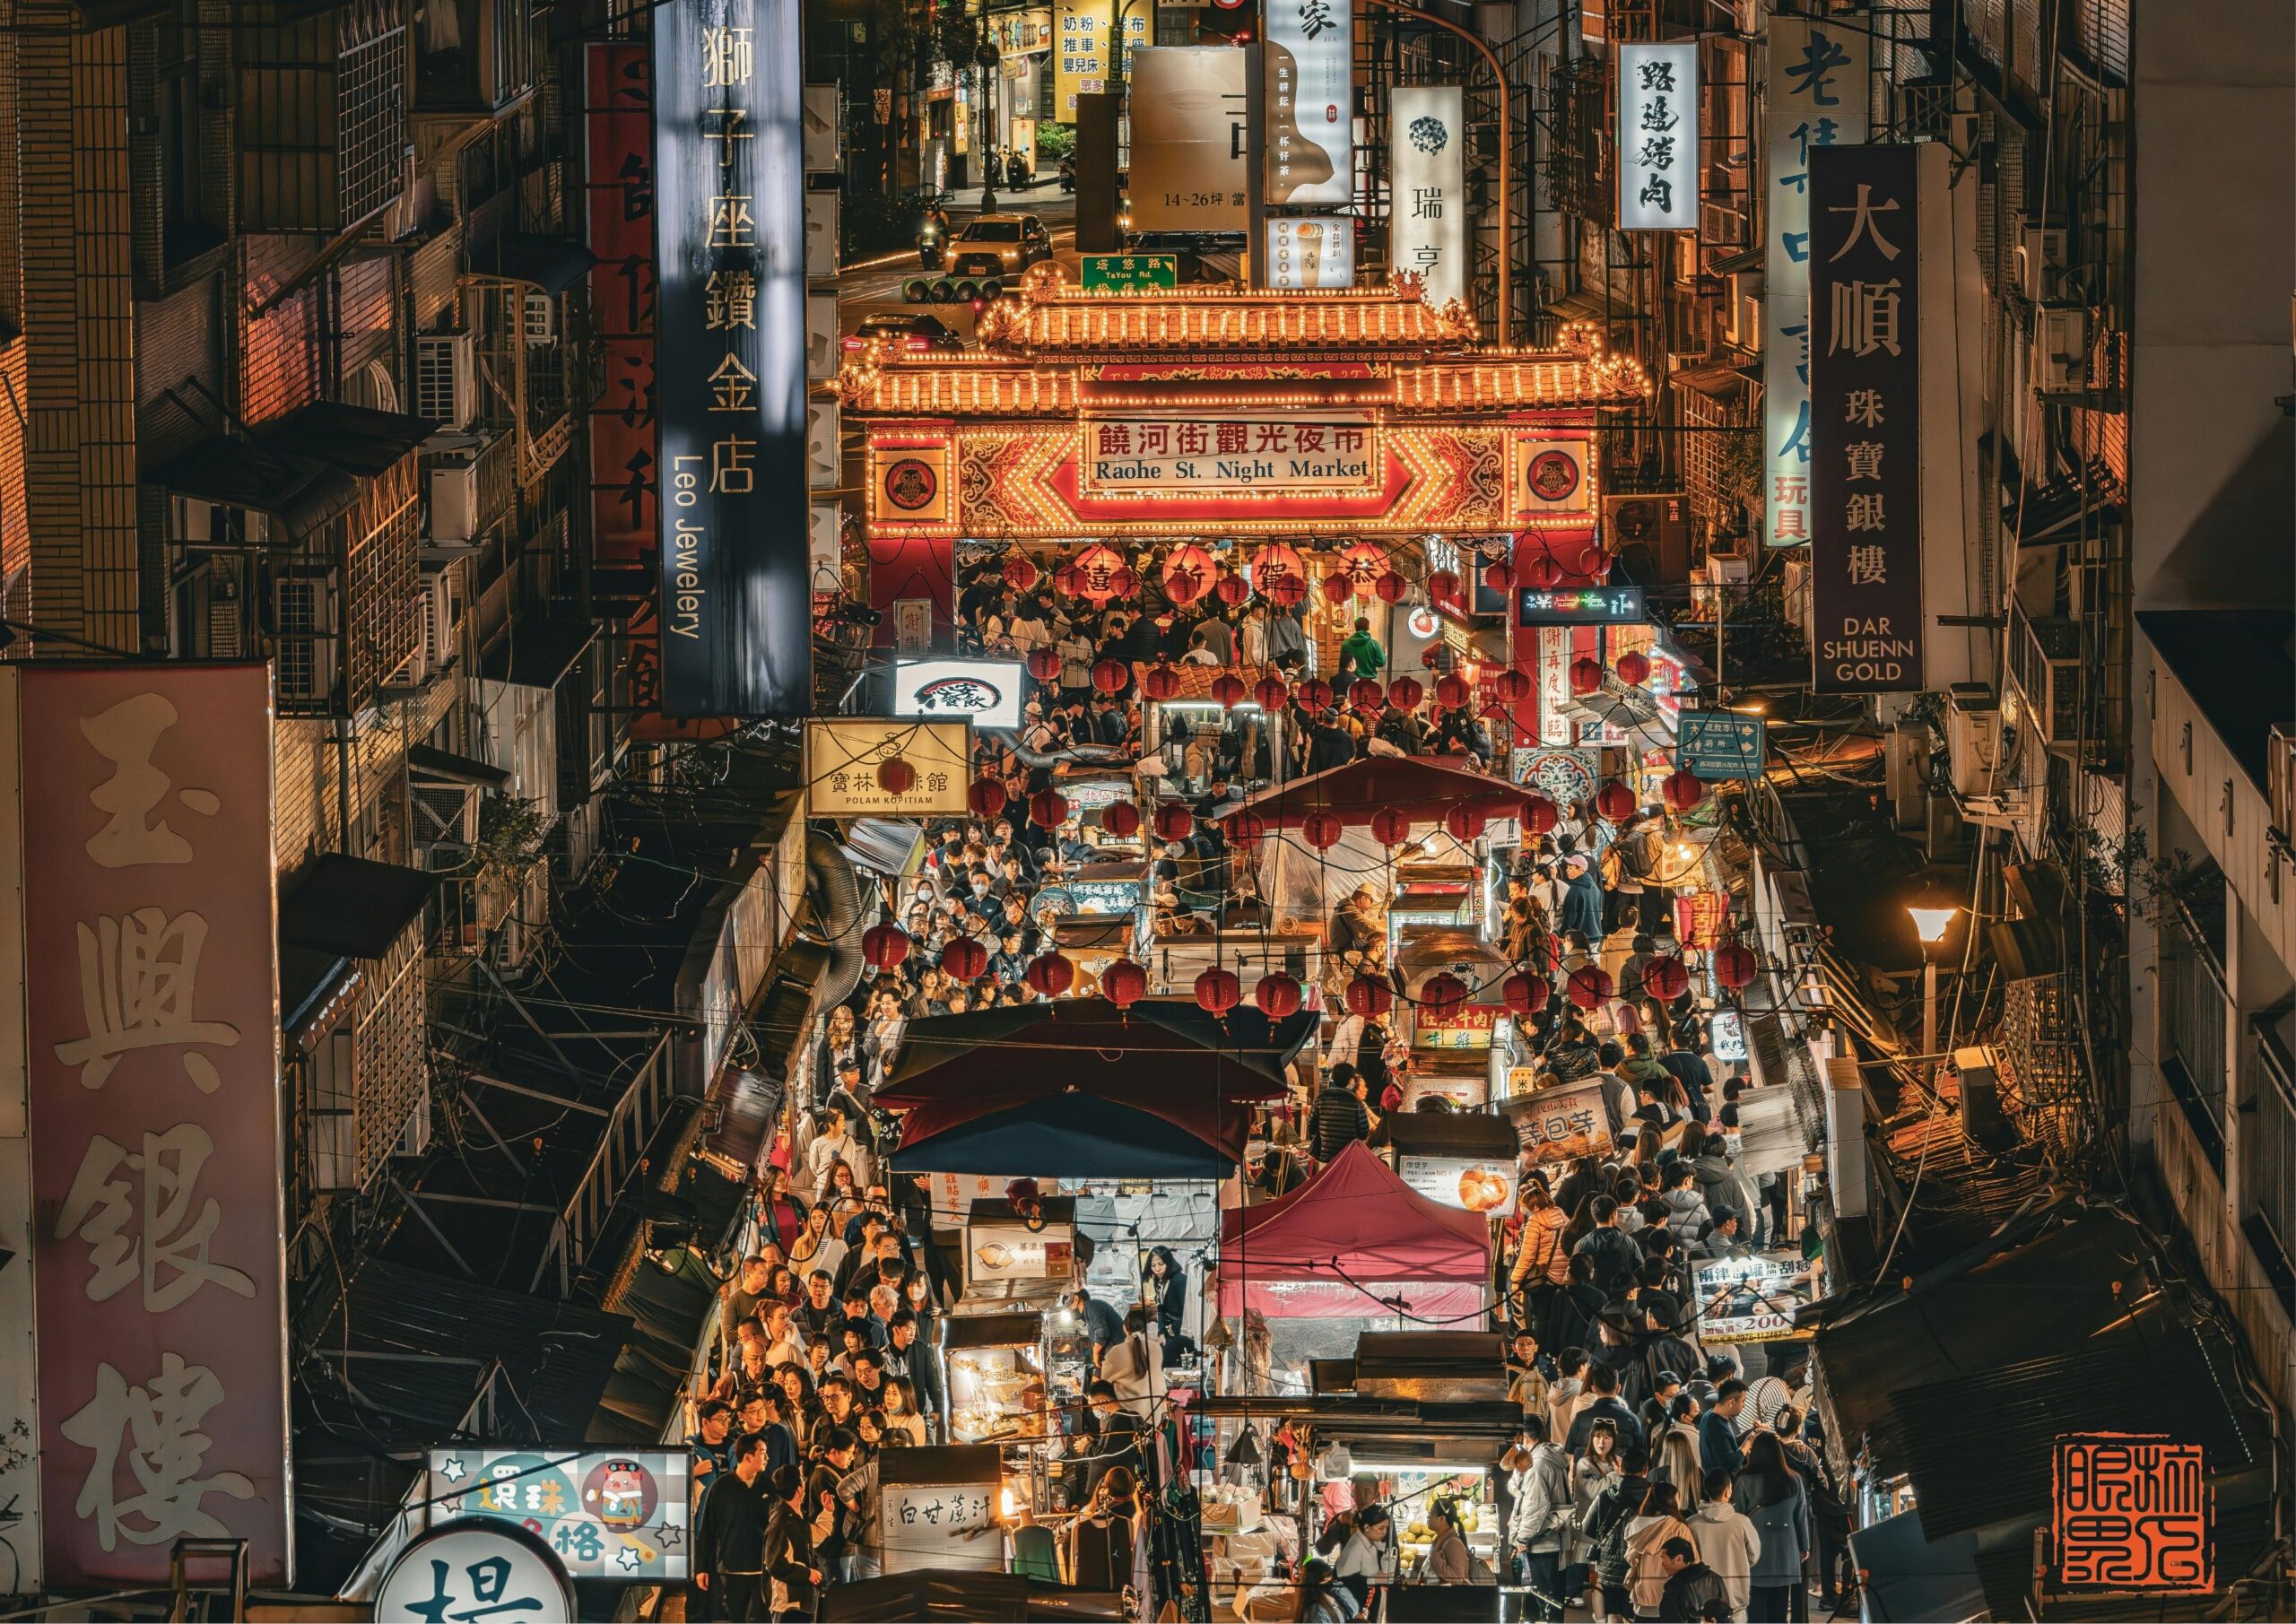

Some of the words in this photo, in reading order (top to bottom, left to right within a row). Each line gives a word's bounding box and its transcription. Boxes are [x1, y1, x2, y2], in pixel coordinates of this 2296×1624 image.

[1299, 0, 1337, 40] 家
[1636, 61, 1678, 214] 路邊烤肉
[702, 27, 758, 495] 獅子座鑽金店
[1096, 257, 1161, 271] 塔悠路
[1098, 423, 1365, 456] 饒河街觀光夜市
[674, 455, 704, 508] Leo
[1096, 461, 1161, 480] Raohe
[1176, 461, 1202, 479] St.
[1216, 460, 1274, 483] Night
[1290, 459, 1369, 478] Market
[1844, 388, 1888, 586] 珠寶銀樓
[1774, 475, 1809, 540] 玩具
[670, 517, 707, 640] Jewelery
[1345, 557, 1378, 584] 恭
[1843, 617, 1892, 636] DAR
[1823, 639, 1915, 659] SHUENN
[1836, 662, 1902, 682] GOLD
[830, 772, 948, 793] 寶林館
[846, 796, 880, 804] POLAM
[884, 796, 933, 804] KOPITIAM
[55, 692, 257, 1552] 玉興銀樓
[1519, 1108, 1596, 1148] 芋包芋
[900, 1492, 991, 1527] 白甘蔗汁
